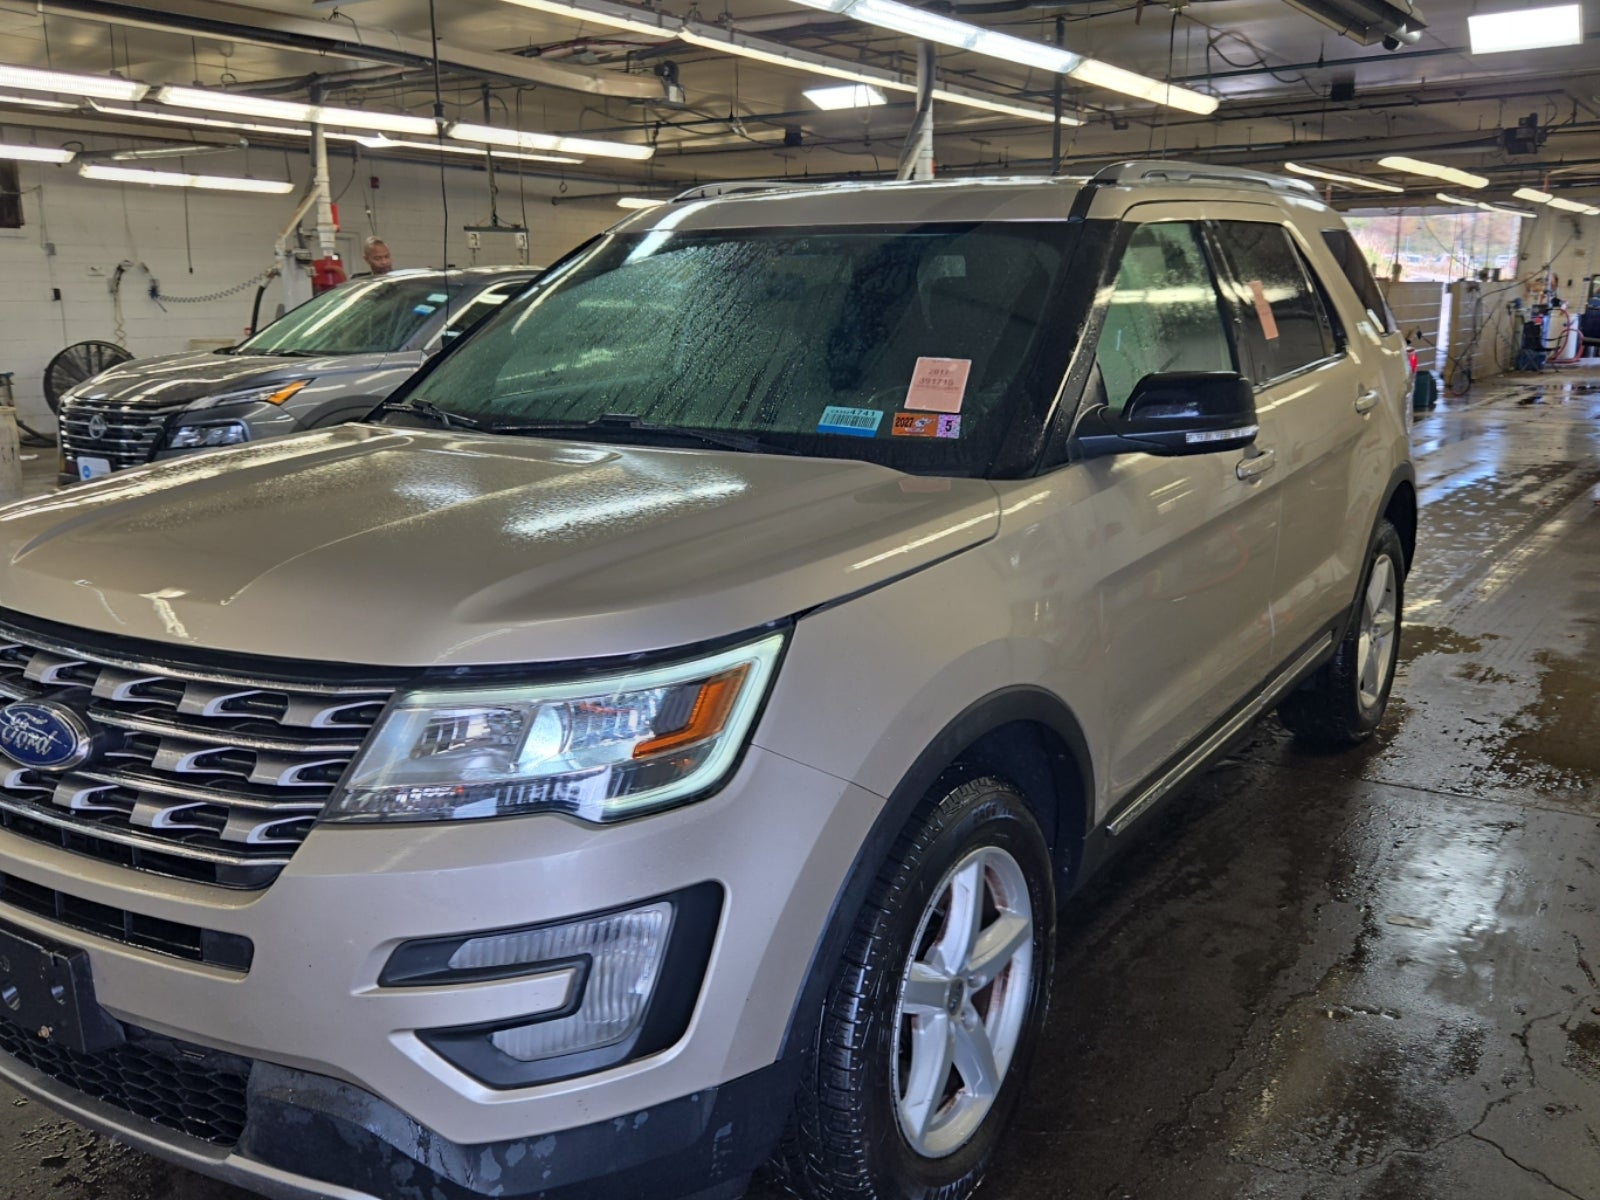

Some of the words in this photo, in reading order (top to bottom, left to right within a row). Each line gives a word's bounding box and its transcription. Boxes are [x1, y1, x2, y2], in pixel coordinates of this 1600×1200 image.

[895, 417, 914, 428] 2027
[944, 420, 952, 432] 5
[1, 711, 62, 756] Ford
